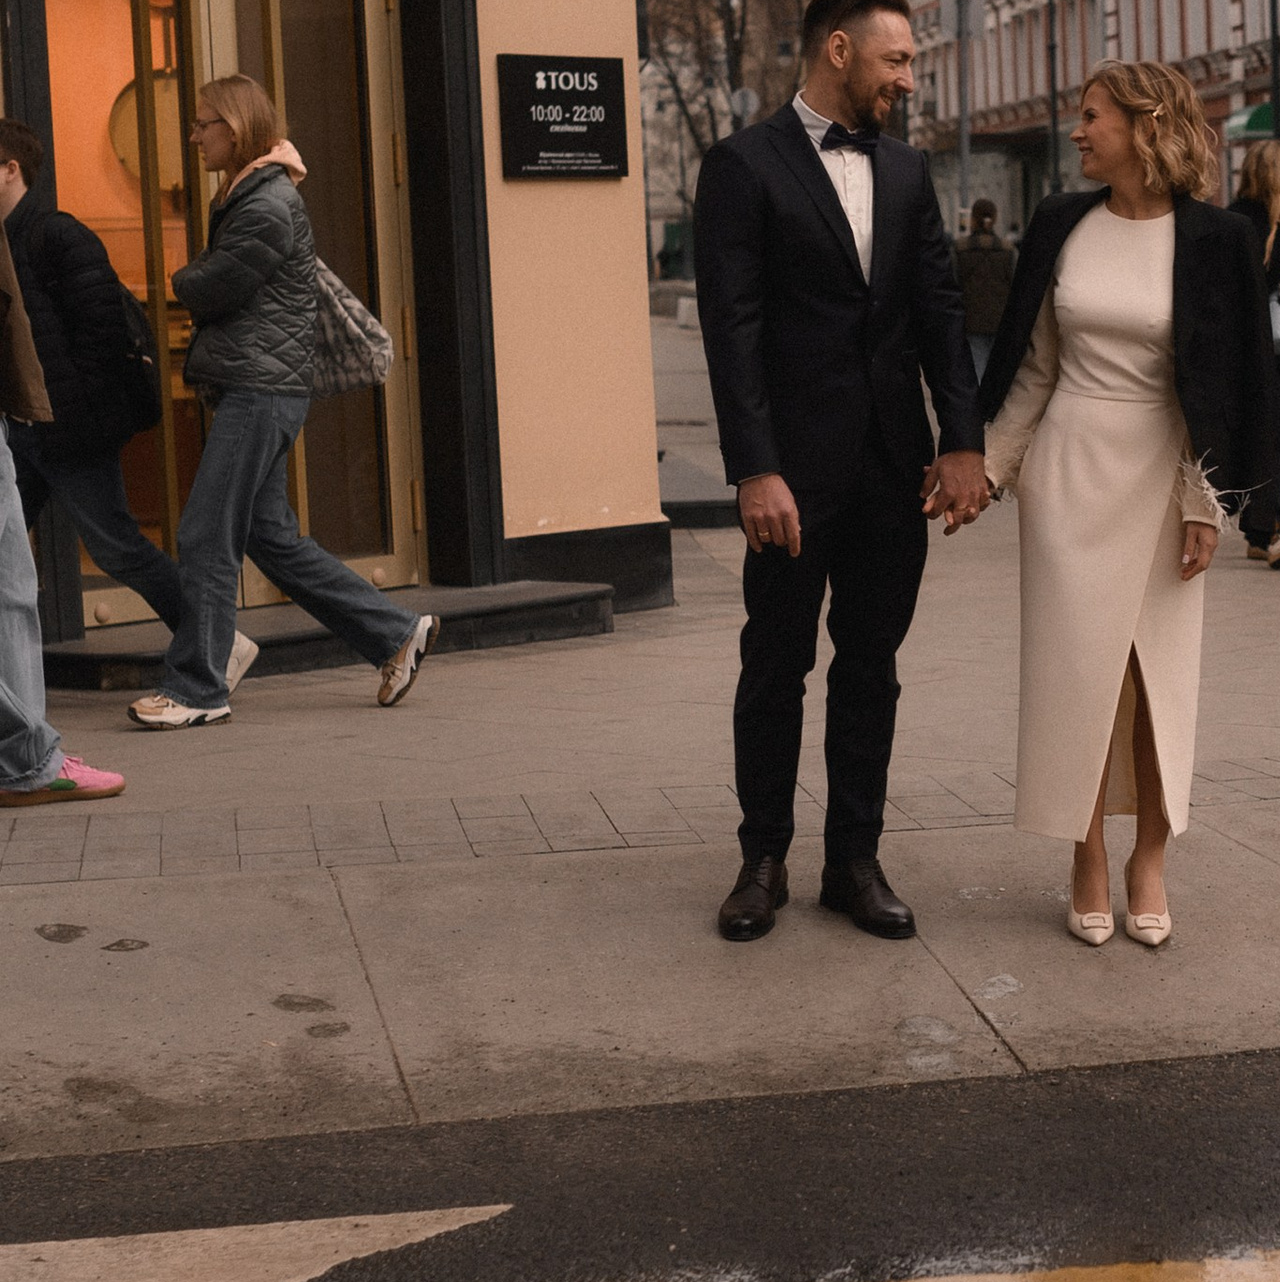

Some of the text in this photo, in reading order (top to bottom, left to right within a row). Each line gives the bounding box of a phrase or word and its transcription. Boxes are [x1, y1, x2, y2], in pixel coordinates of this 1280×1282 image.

[547, 71, 598, 91] TOUS
[530, 105, 562, 122] 10:00
[572, 105, 605, 122] 22:00
